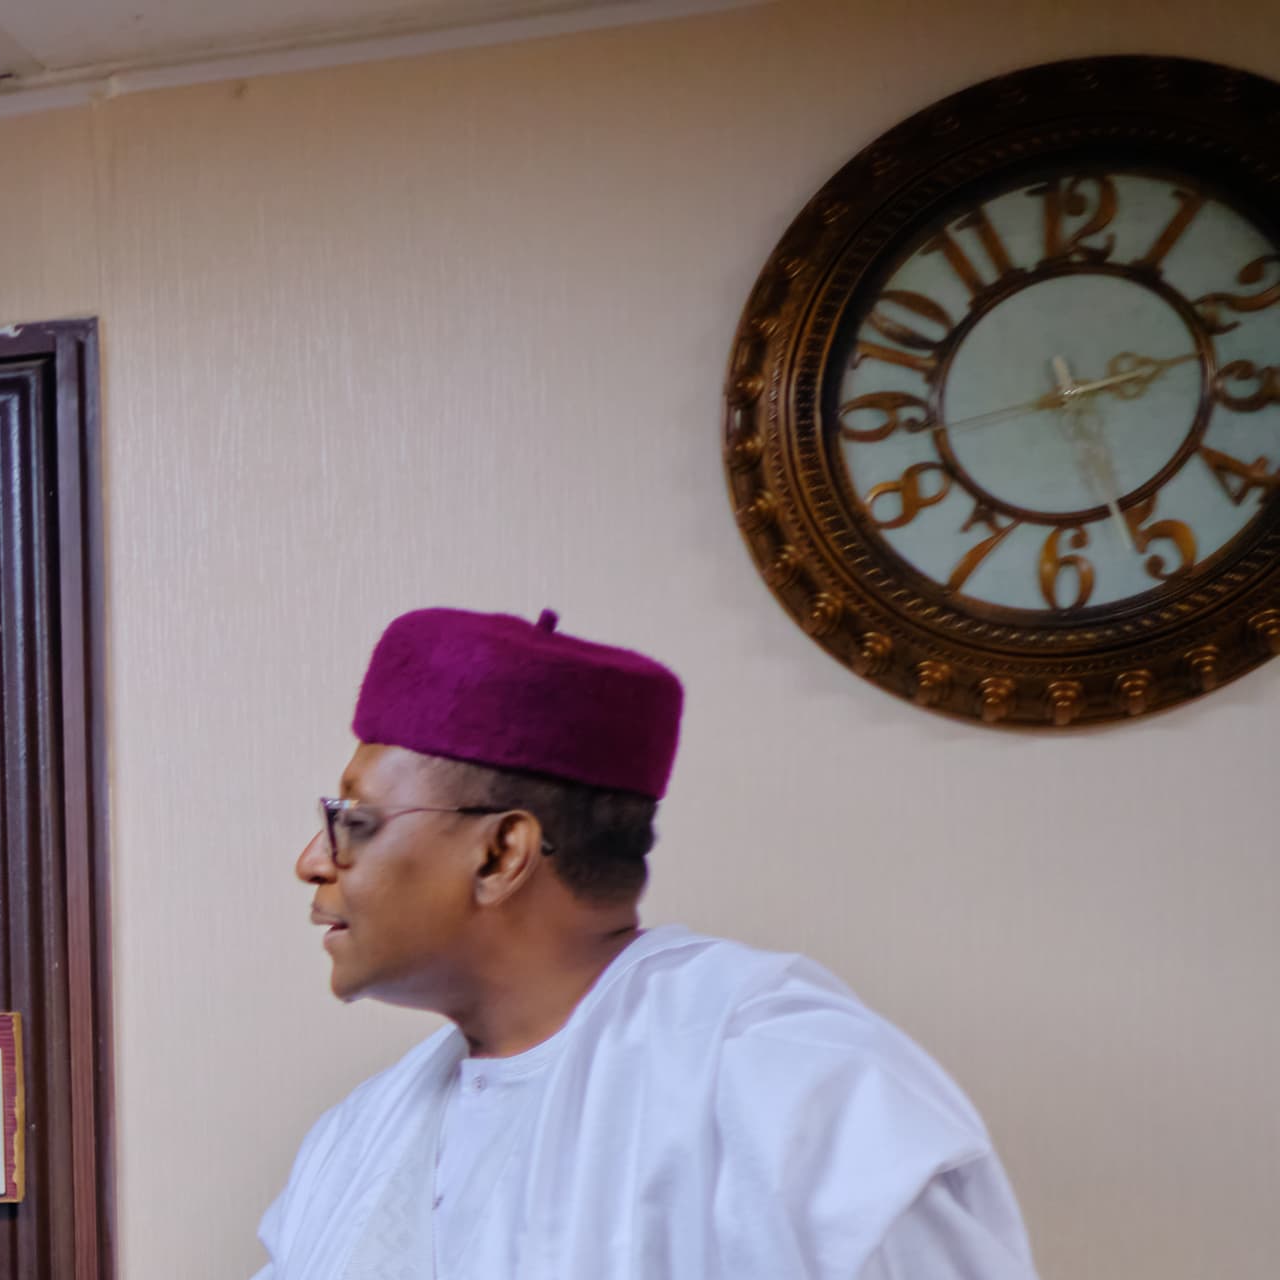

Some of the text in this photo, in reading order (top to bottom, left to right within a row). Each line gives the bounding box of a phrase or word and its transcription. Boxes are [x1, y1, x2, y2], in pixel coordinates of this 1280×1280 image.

[916, 202, 1030, 312] 11
[1025, 173, 1118, 267] 12
[1130, 186, 1205, 280] 1
[852, 289, 956, 386] 10
[839, 391, 940, 443] 9
[864, 461, 952, 530] 8
[1198, 445, 1280, 508] 4
[946, 502, 1023, 595] 7
[1037, 523, 1096, 613] 6
[1124, 494, 1198, 582] 5
